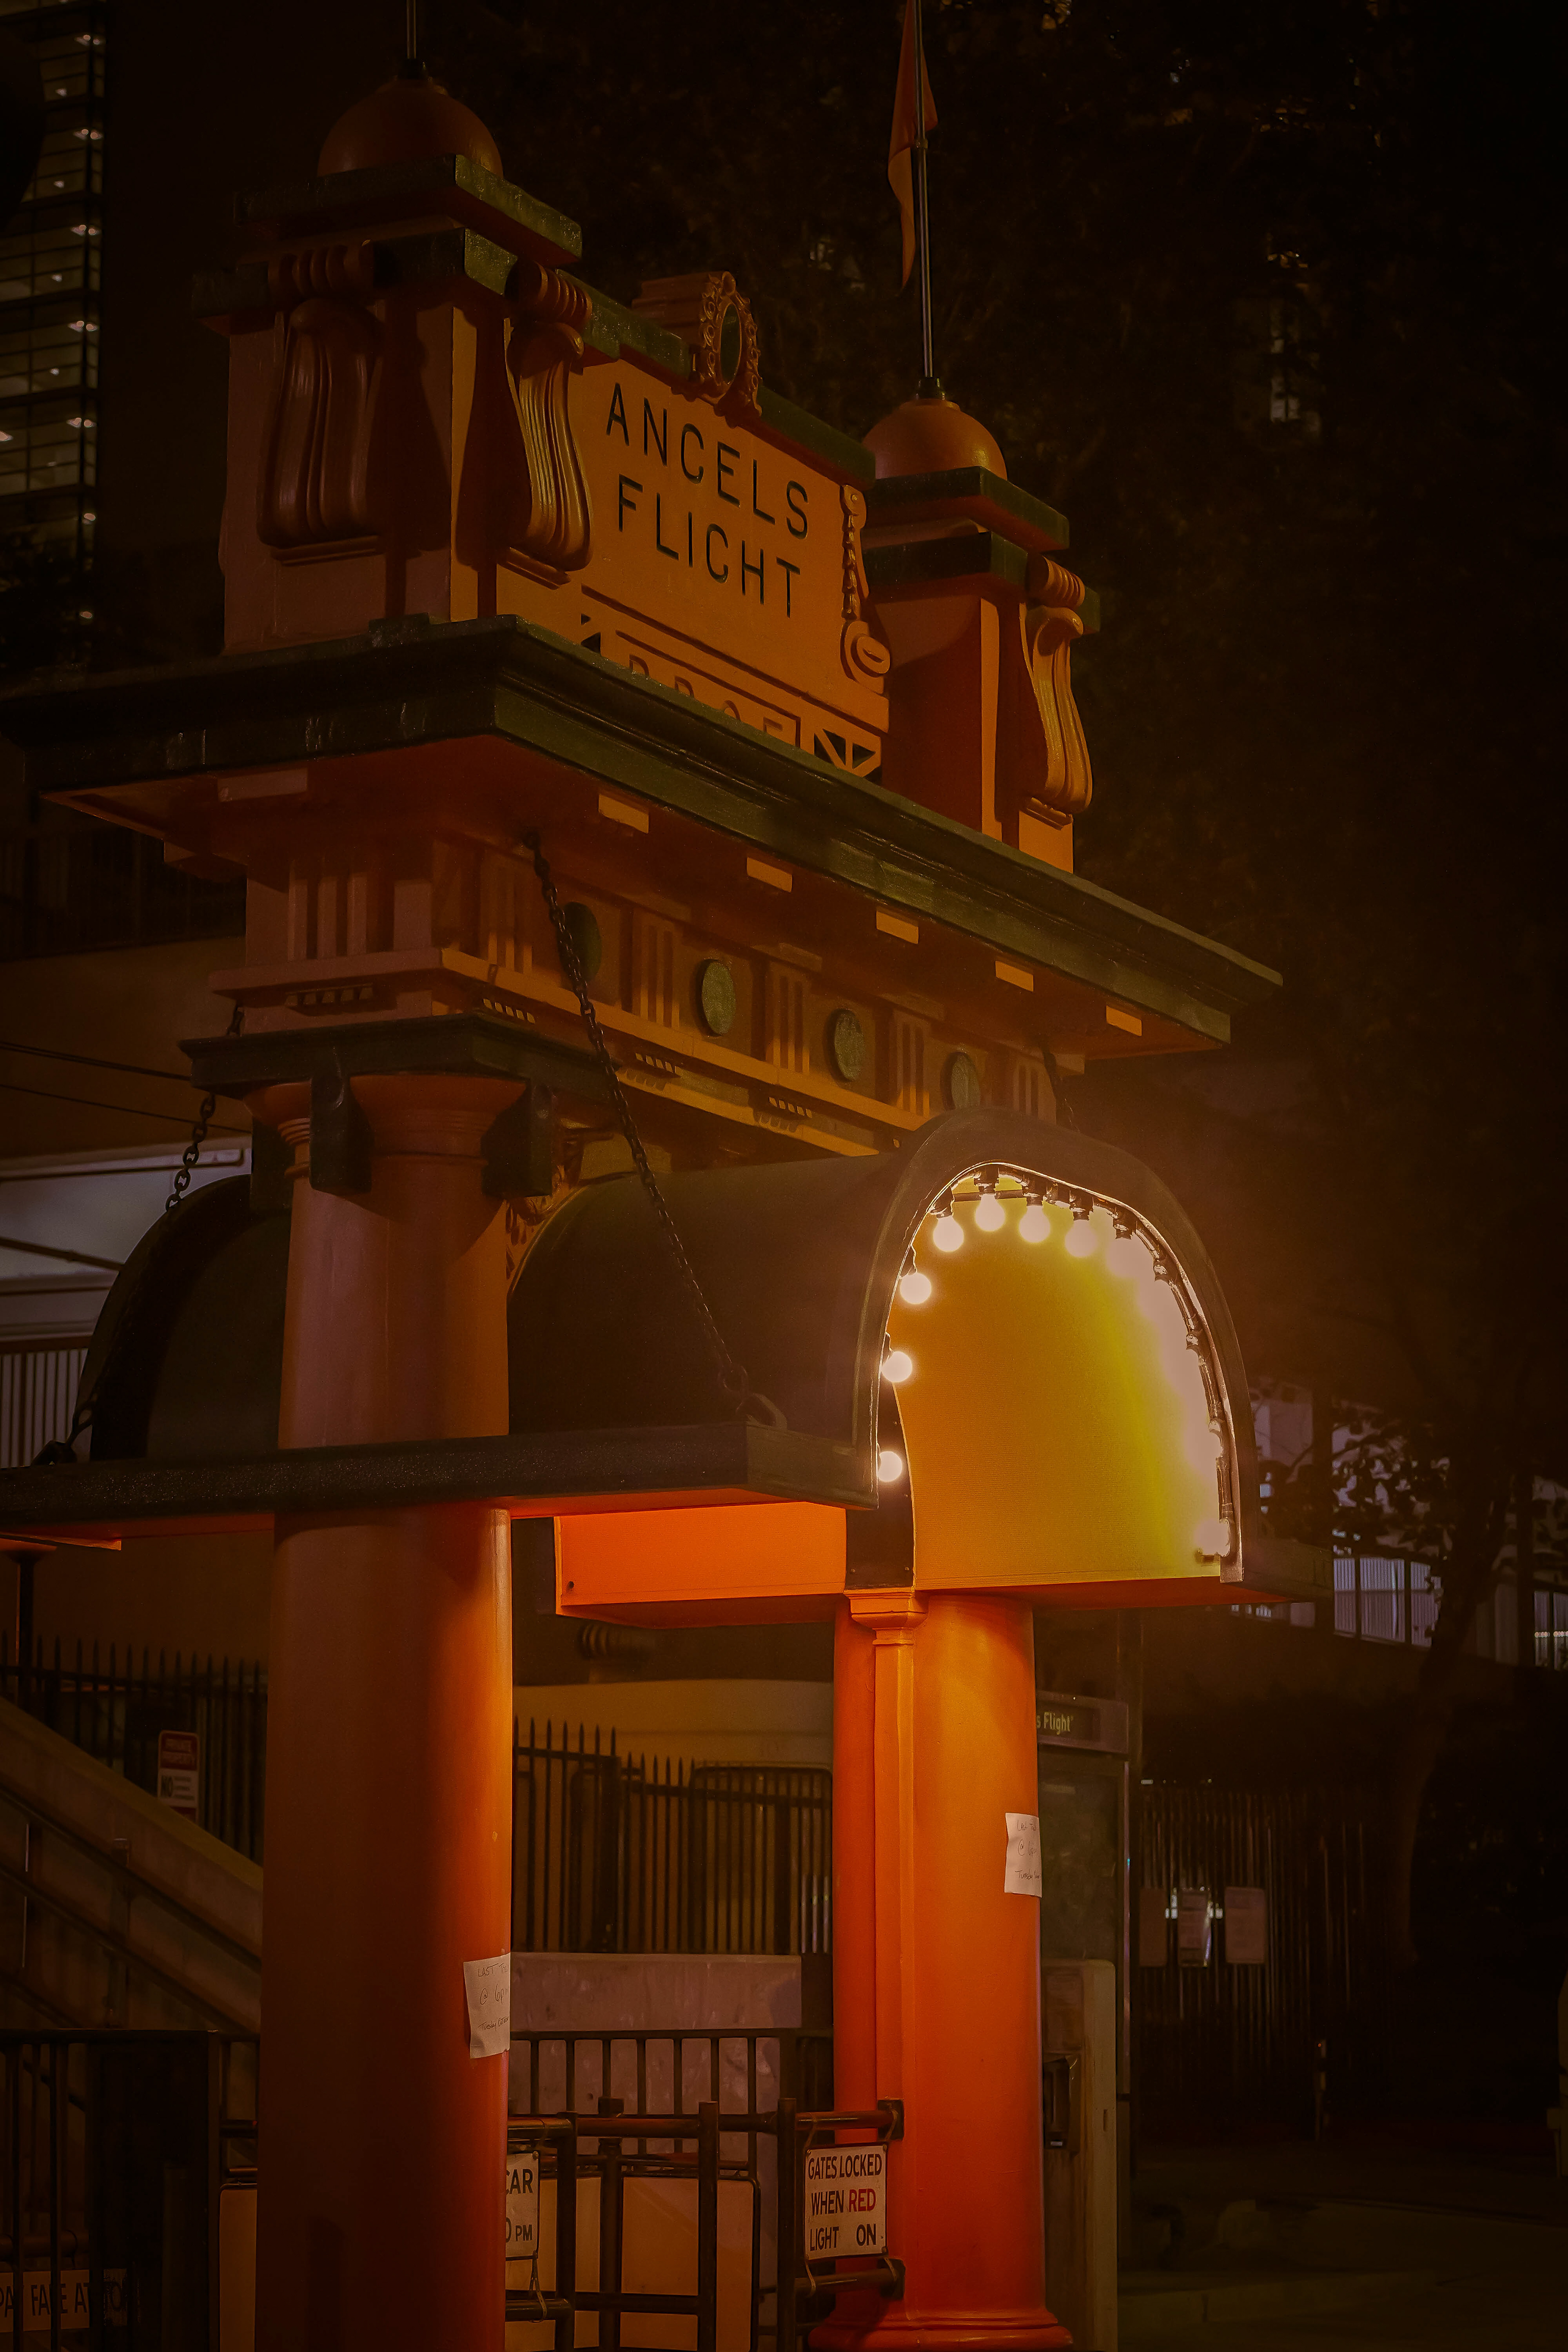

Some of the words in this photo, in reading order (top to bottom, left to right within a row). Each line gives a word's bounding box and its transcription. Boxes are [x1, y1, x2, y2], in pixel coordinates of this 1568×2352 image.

[480, 1988, 488, 2005] @
[808, 2156, 837, 2180] GATES
[840, 2154, 882, 2178] LOCKED
[811, 2189, 844, 2216] WHEN
[849, 2188, 876, 2212] RED
[515, 2225, 532, 2242] PM
[810, 2226, 839, 2252] LIGHT
[856, 2223, 877, 2246] ON
